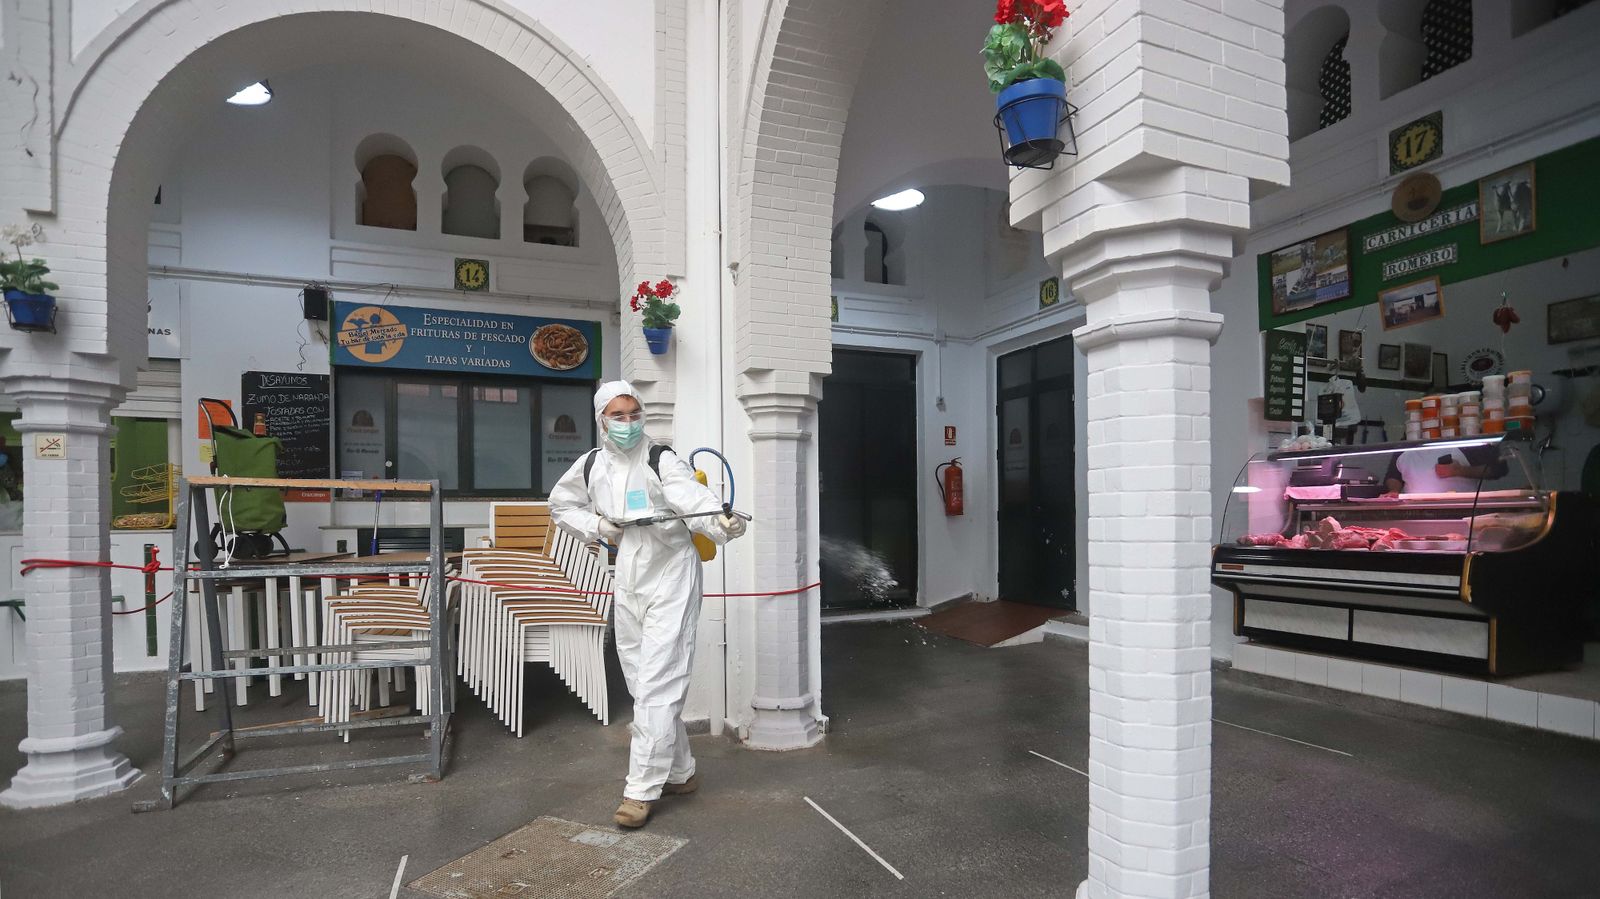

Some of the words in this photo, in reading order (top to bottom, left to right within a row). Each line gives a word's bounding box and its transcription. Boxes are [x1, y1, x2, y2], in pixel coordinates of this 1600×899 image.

[1404, 130, 1428, 159] 17
[1367, 205, 1476, 248] CARNICERIA
[1387, 247, 1452, 275] ROMERO
[465, 268, 480, 283] 14
[1045, 284, 1054, 300] 16
[423, 313, 498, 330] ESPECIALIDAD
[501, 320, 515, 331] EN
[411, 327, 461, 340] FRITURAS
[464, 331, 478, 341] DE
[481, 333, 526, 344] PESCADO
[466, 345, 473, 353] Y
[425, 355, 458, 366] TAPAS
[460, 357, 511, 368] VARIADAS
[277, 393, 291, 404] DE
